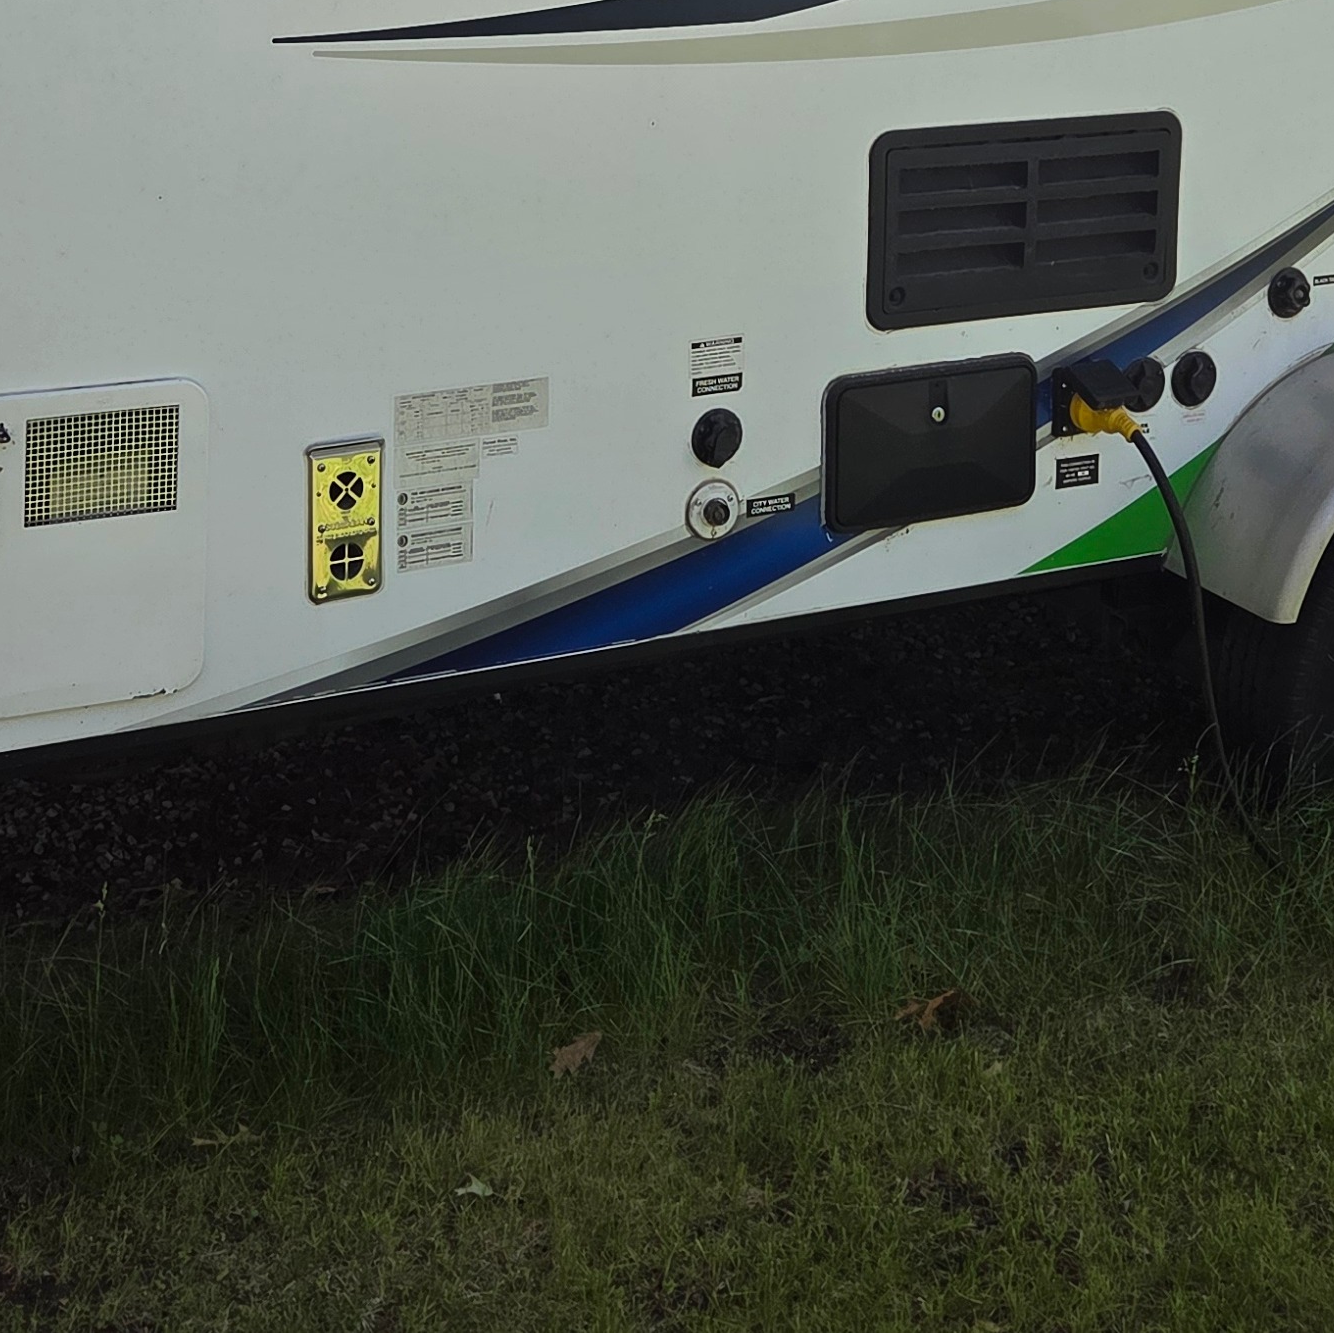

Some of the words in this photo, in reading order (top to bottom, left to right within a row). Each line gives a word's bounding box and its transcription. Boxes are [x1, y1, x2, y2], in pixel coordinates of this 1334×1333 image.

[696, 379, 717, 387] FRESH
[718, 376, 740, 384] WATER
[696, 382, 739, 394] CONNECTION
[752, 500, 767, 508] CITY
[767, 496, 790, 506] WATER
[750, 503, 792, 515] CONNECTION
